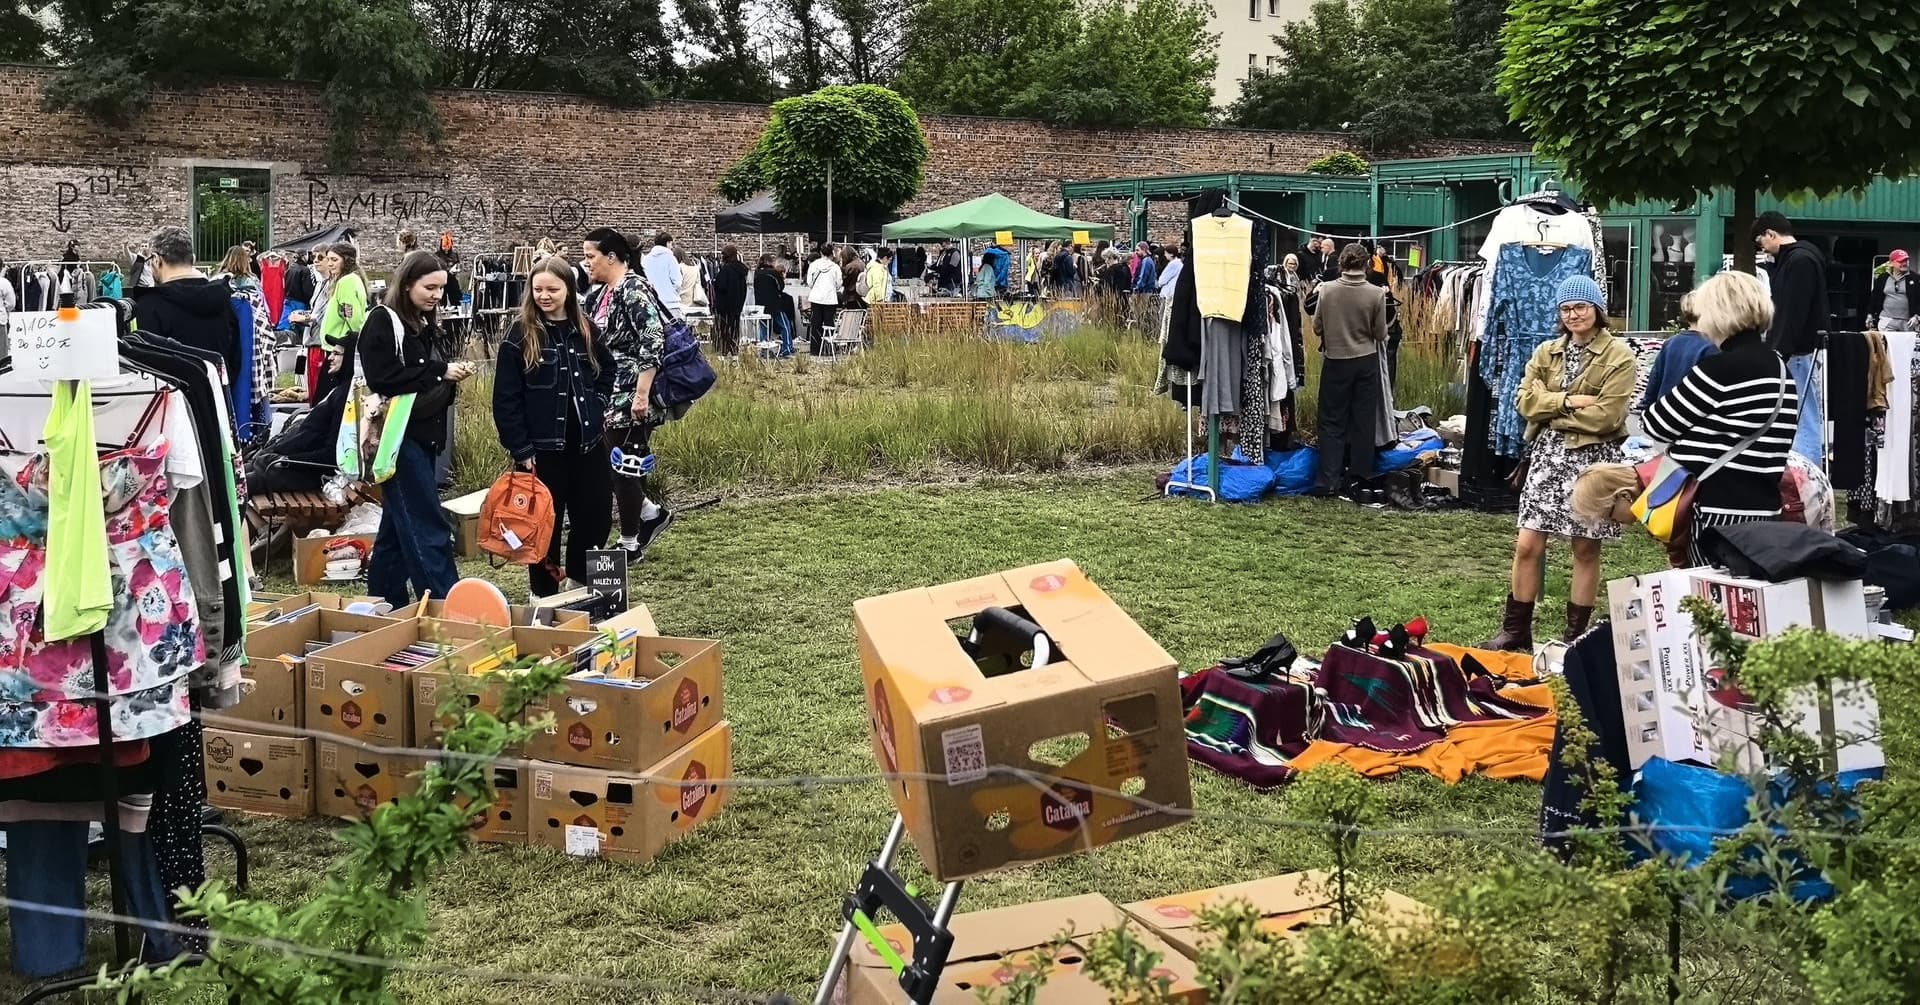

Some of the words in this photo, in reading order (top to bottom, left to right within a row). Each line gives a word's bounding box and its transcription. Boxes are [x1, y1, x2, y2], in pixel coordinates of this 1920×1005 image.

[1516, 190, 1560, 202] SIEMENS
[35, 336, 56, 348] 20
[596, 561, 615, 571] DOM
[1651, 580, 1667, 632] Tefal
[675, 700, 697, 727] Catalina
[682, 782, 706, 811] Catalina
[1045, 800, 1091, 824] Catalina
